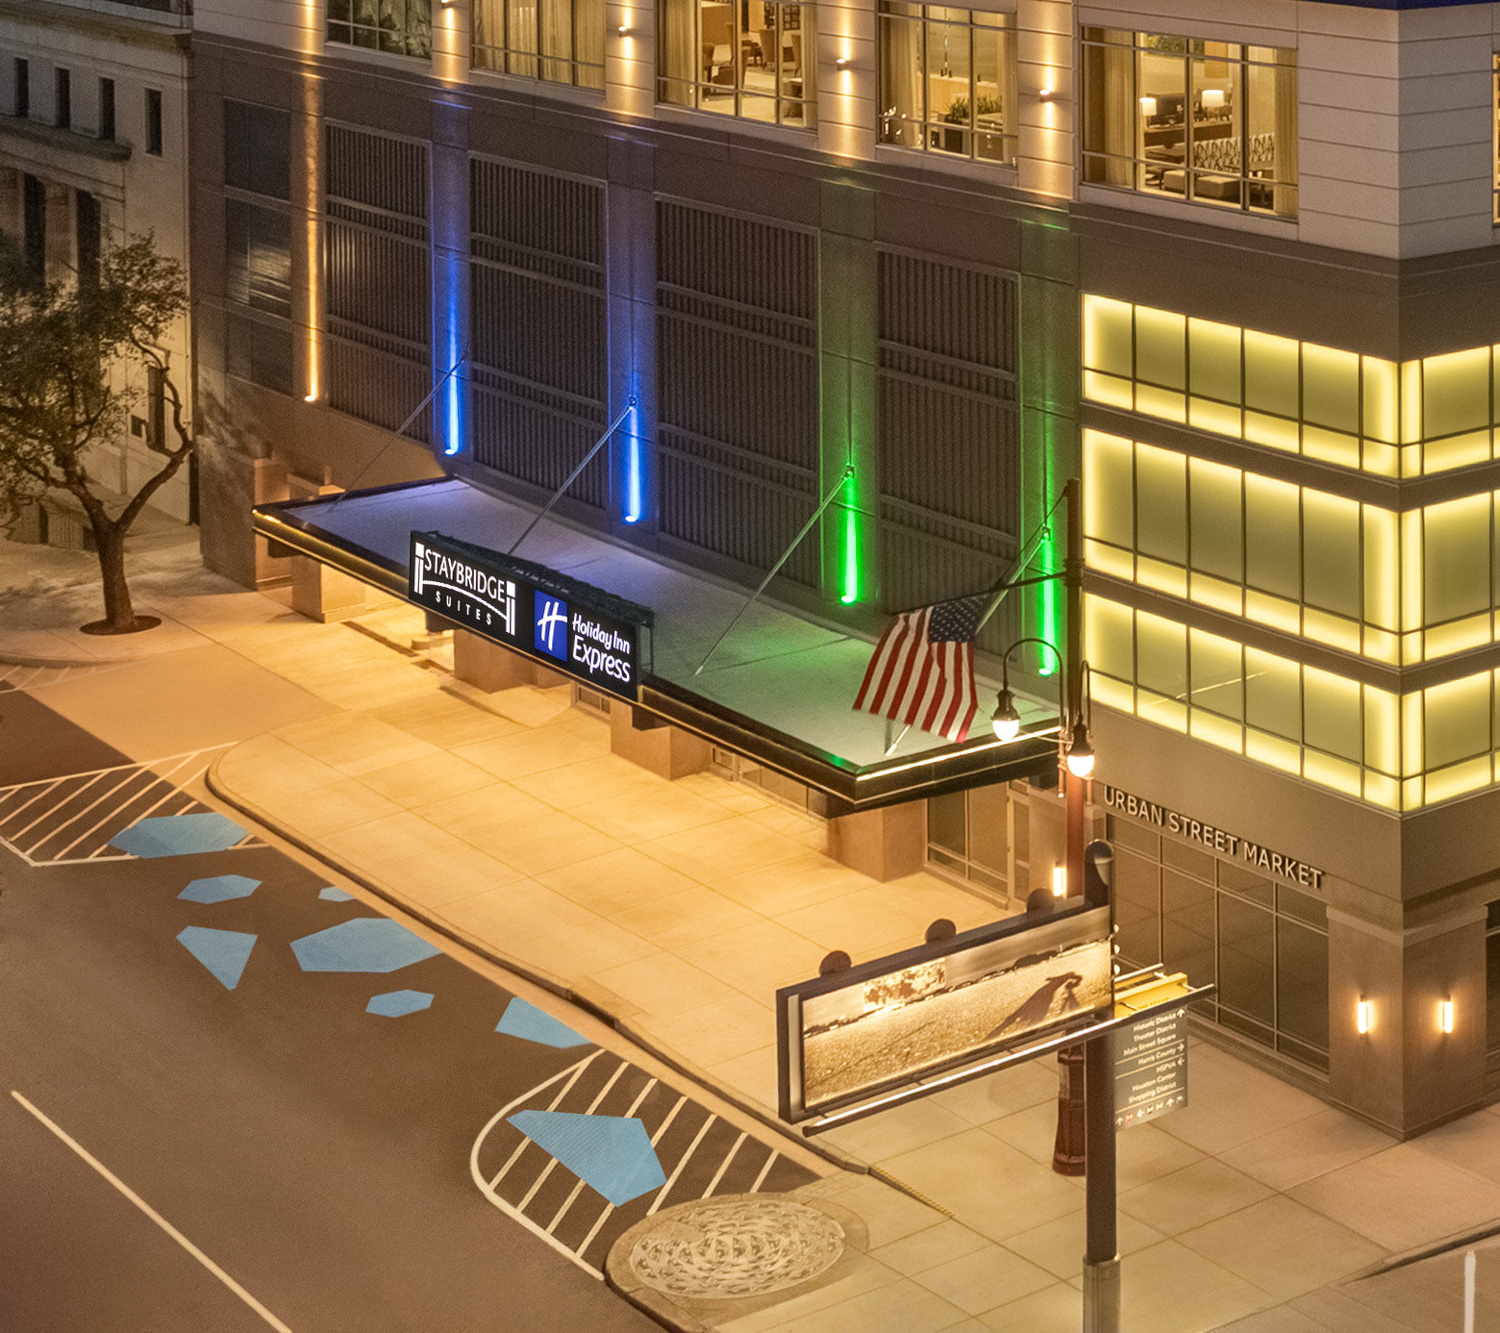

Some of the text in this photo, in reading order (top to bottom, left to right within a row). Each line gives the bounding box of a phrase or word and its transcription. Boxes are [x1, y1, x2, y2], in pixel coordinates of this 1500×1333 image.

[424, 548, 506, 603] STAYBRIDGE
[435, 590, 493, 626] SUITES
[572, 612, 631, 655] Holiday Inn
[572, 634, 632, 683] Express
[1103, 784, 1323, 890] URBAN STREET MARKET
[1133, 1013, 1176, 1032] Historic District
[1156, 1022, 1177, 1035] District
[1123, 1034, 1177, 1056] Main Street Square
[1138, 1048, 1176, 1065] Harris County
[1128, 1082, 1177, 1103] Shopping District
[1132, 1072, 1177, 1092] Houston Center
